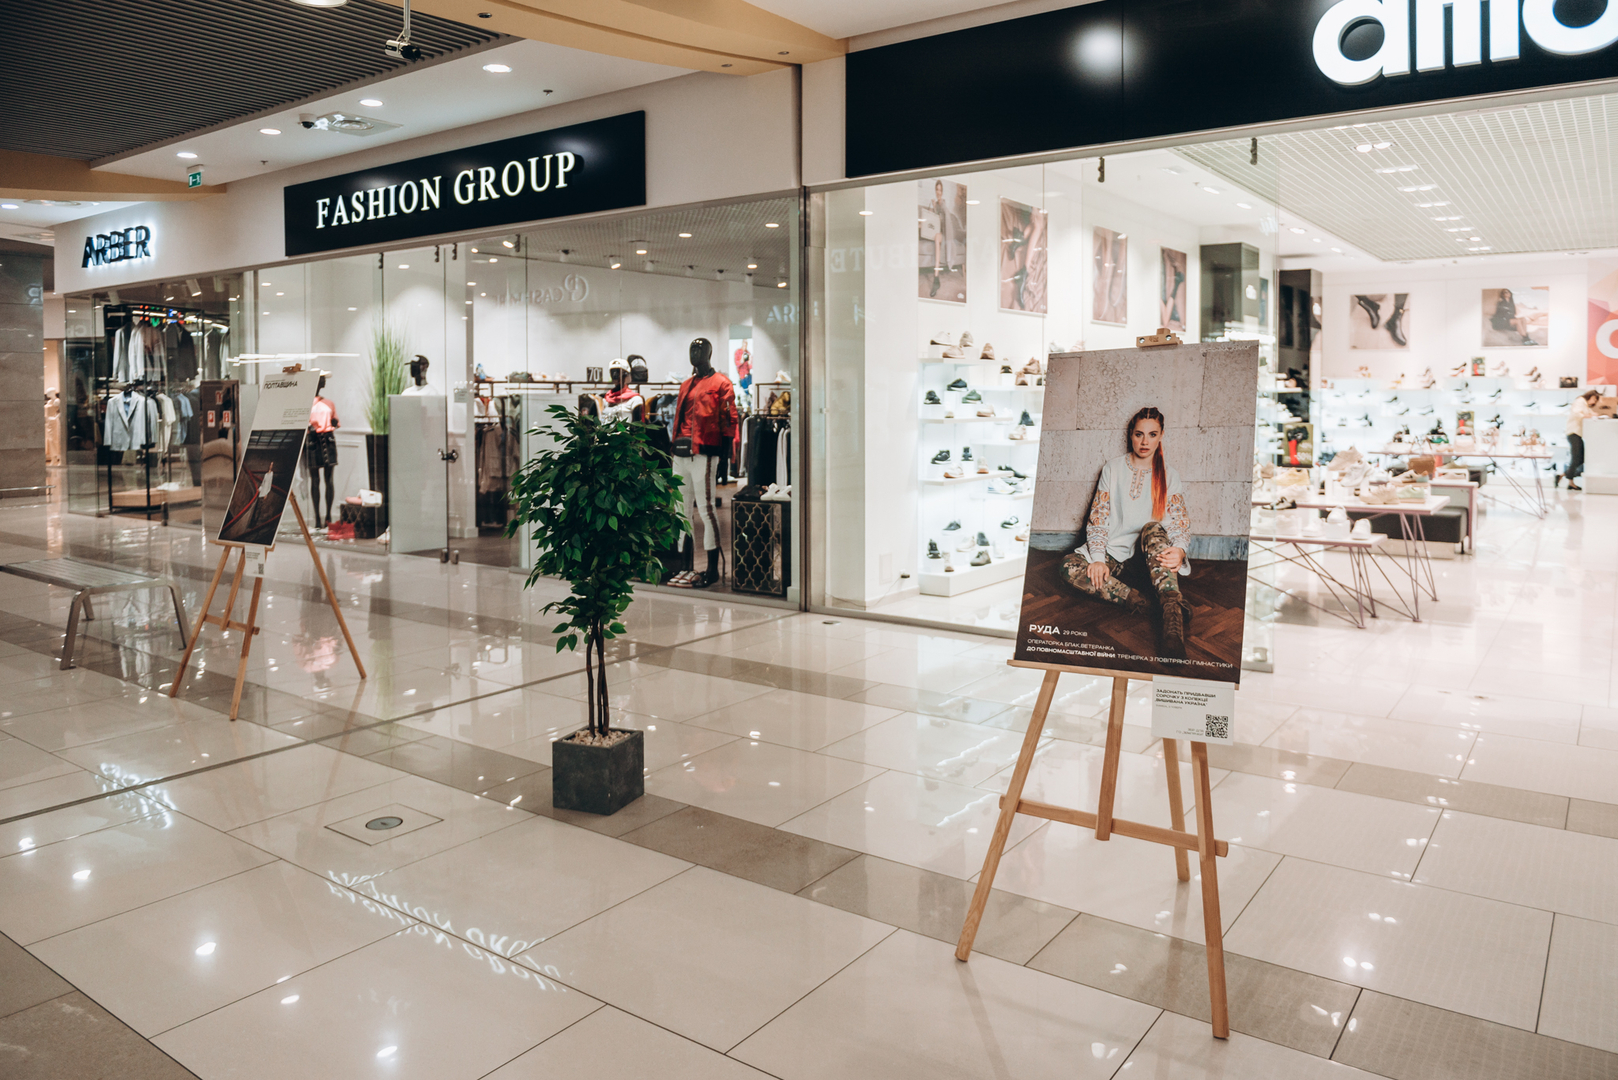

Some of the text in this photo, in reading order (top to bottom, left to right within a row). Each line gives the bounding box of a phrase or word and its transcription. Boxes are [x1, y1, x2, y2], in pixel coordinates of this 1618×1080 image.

[316, 151, 575, 229] FASHION GROUP
[81, 225, 151, 268] ARBER
[1029, 624, 1060, 635] РУДА
[1027, 639, 1064, 647] ОПЕРАТОРКА
[1081, 643, 1115, 651] ВЕТЕРАНКА
[1117, 653, 1149, 661] ТРЕНЕРКА
[1192, 660, 1233, 669] ГІМНАСТИКИ
